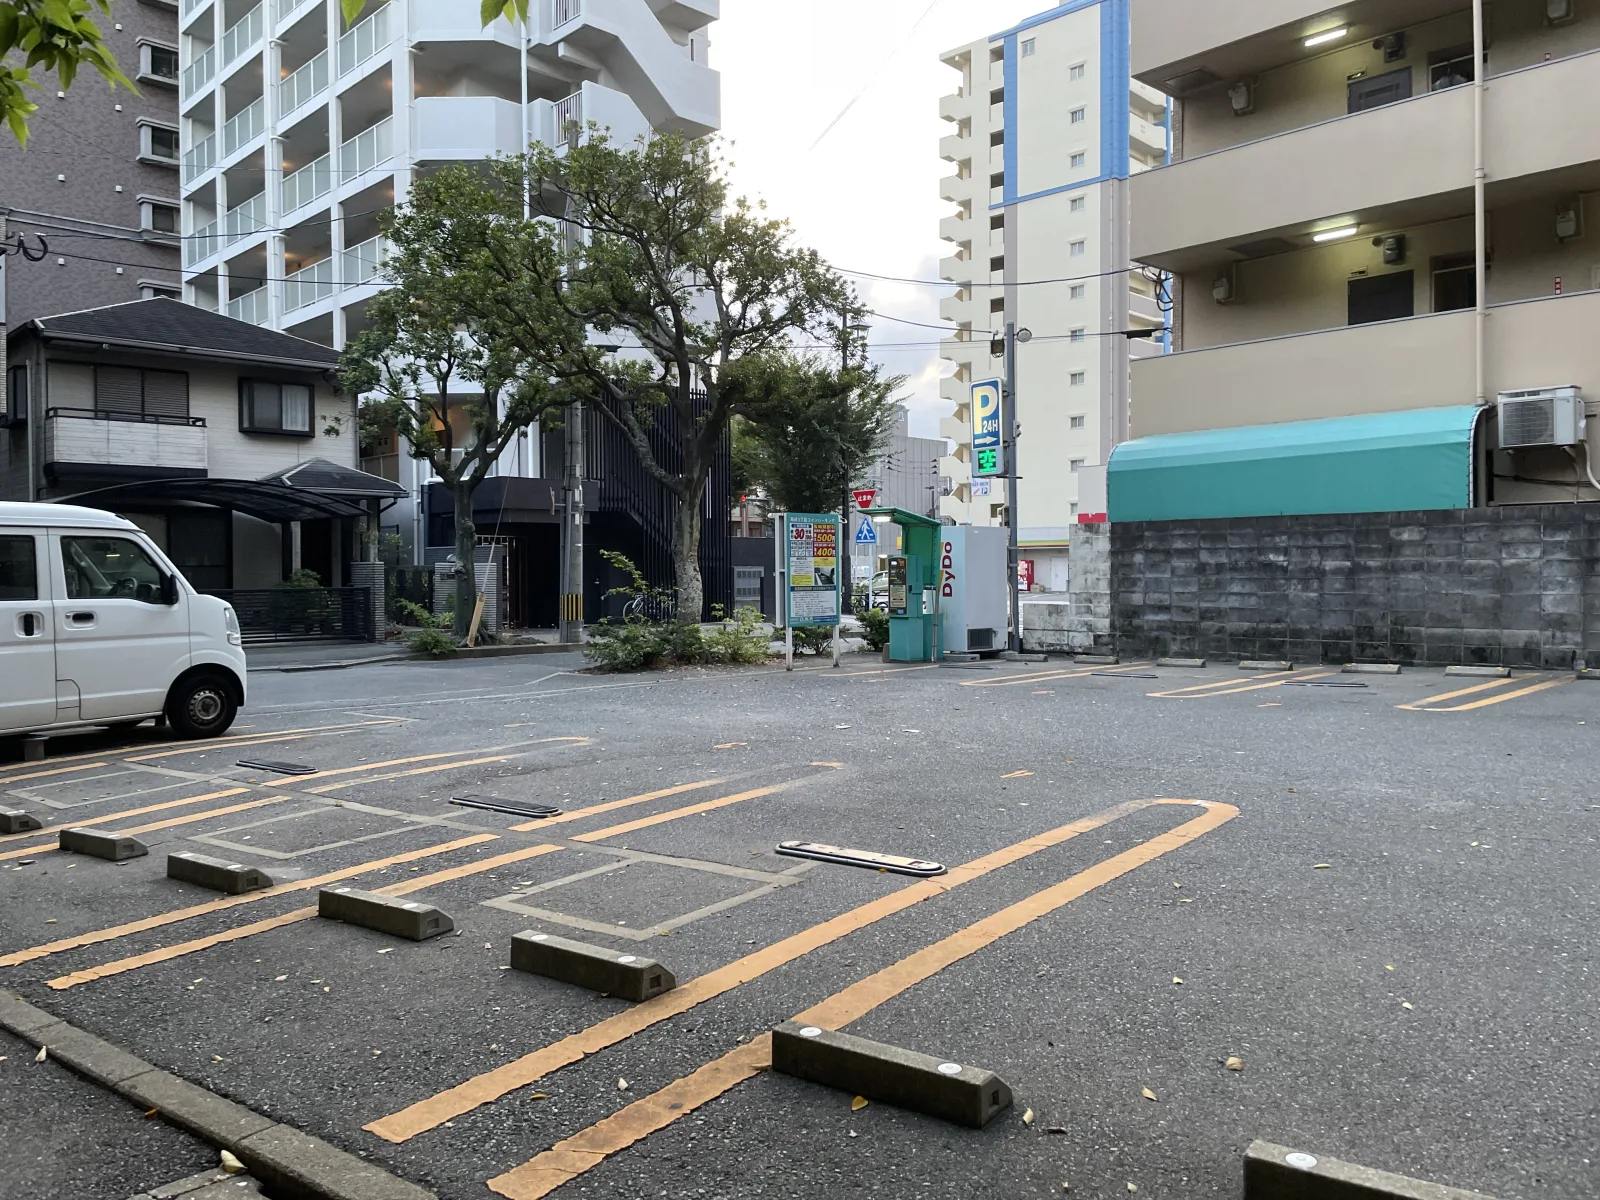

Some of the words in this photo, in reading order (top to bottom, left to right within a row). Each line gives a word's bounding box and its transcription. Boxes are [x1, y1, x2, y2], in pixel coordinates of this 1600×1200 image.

[973, 385, 998, 434] P
[983, 419, 998, 433] 24H
[978, 449, 997, 474] 空
[857, 494, 873, 502] 止まれ
[794, 529, 804, 540] 30
[942, 541, 956, 597] DyDo
